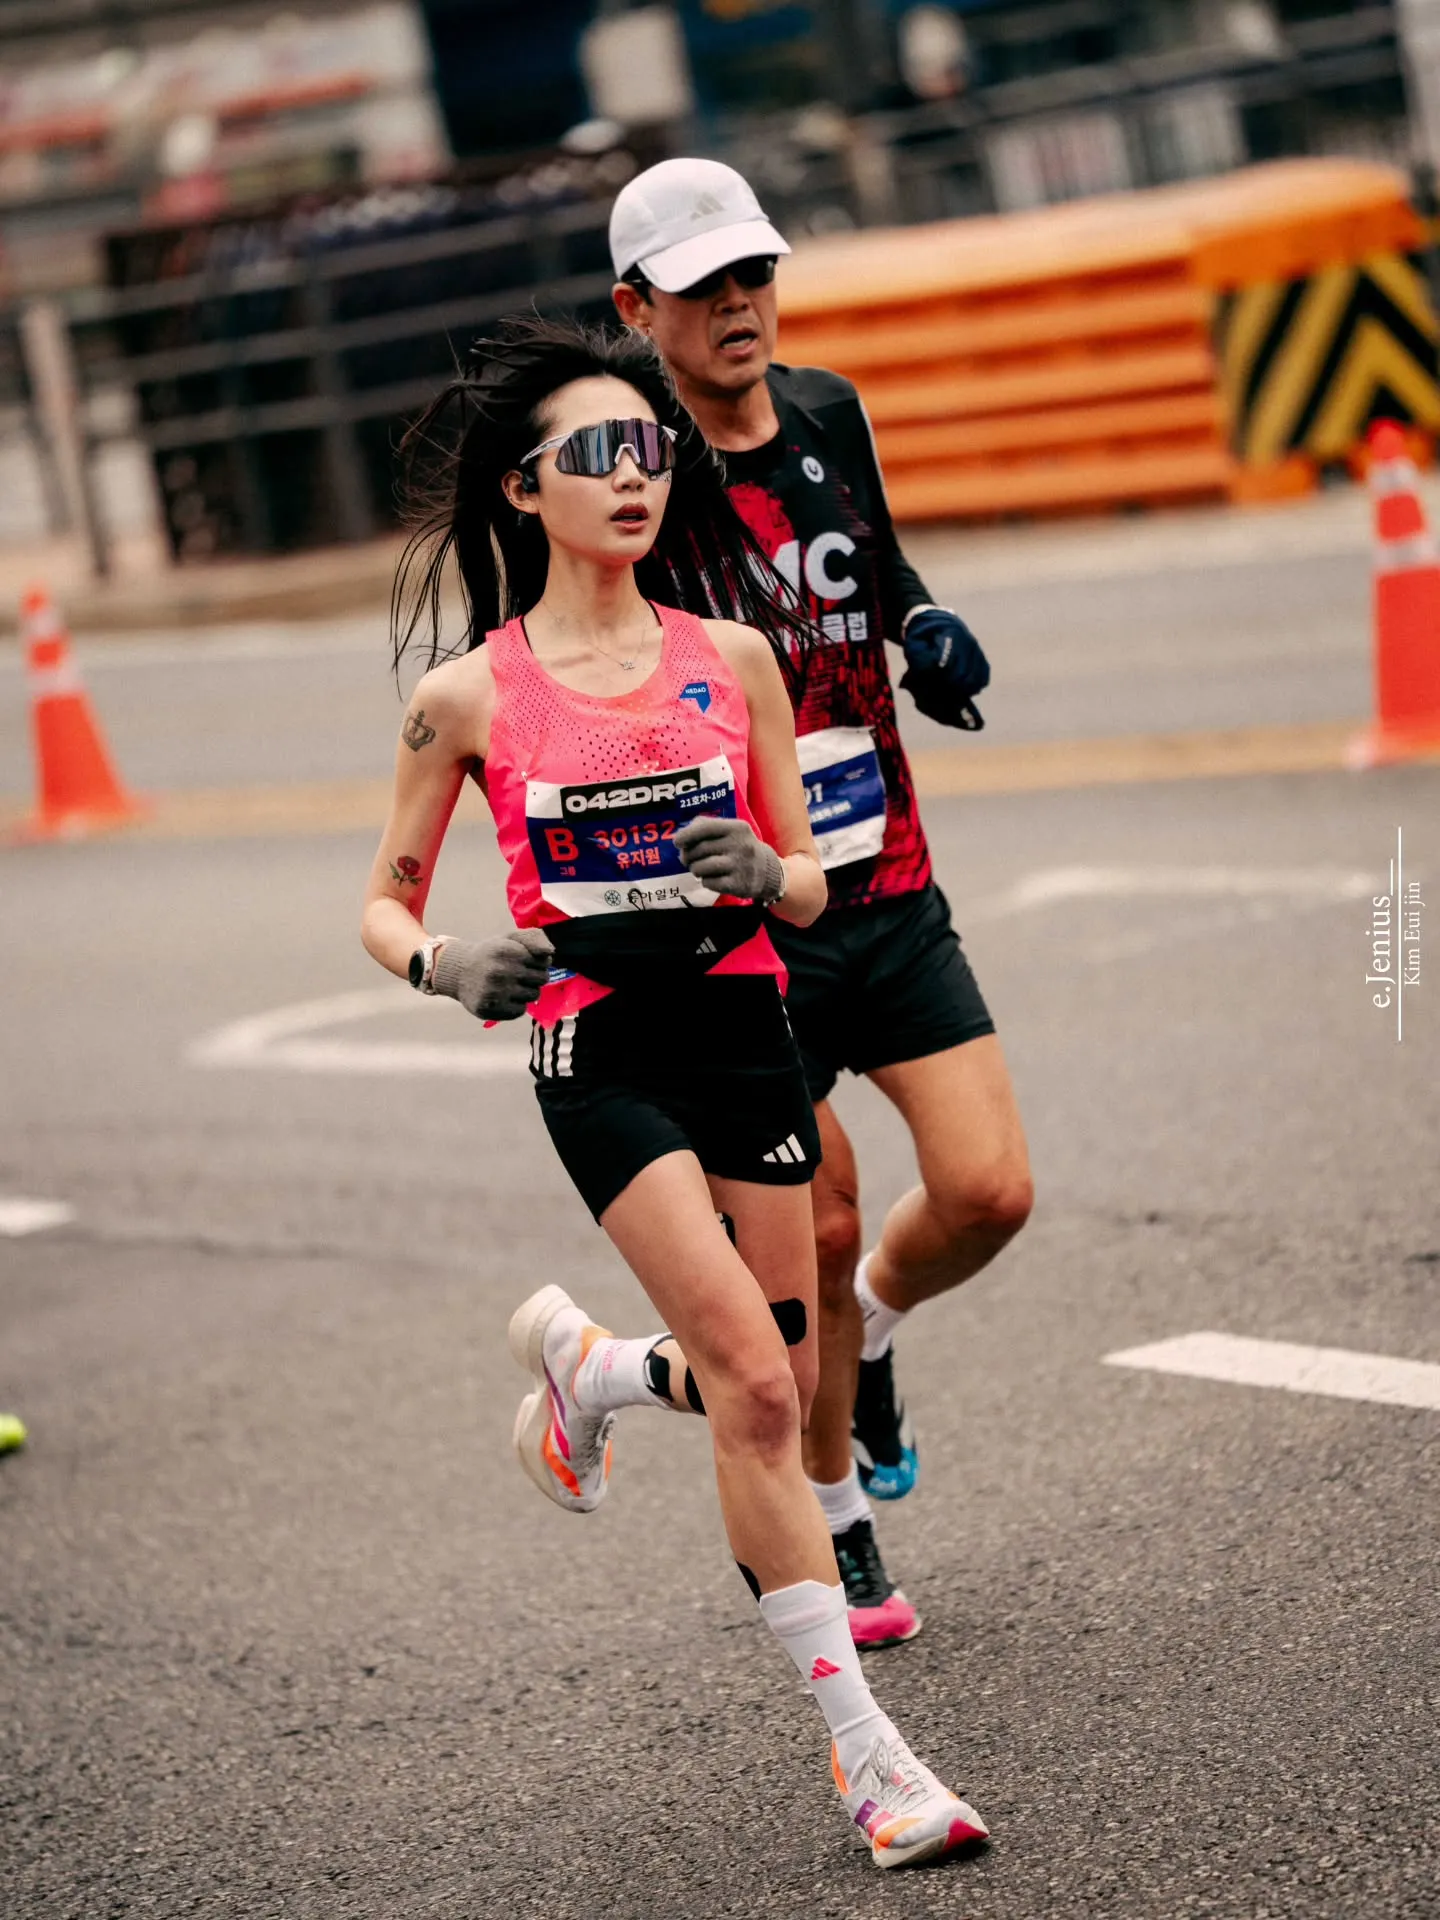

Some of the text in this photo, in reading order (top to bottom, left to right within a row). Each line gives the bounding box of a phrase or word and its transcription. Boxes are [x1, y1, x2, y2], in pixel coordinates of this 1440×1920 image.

[565, 778, 699, 813] 042DRC
[544, 820, 678, 862] B 30132
[616, 846, 662, 870] 유지원
